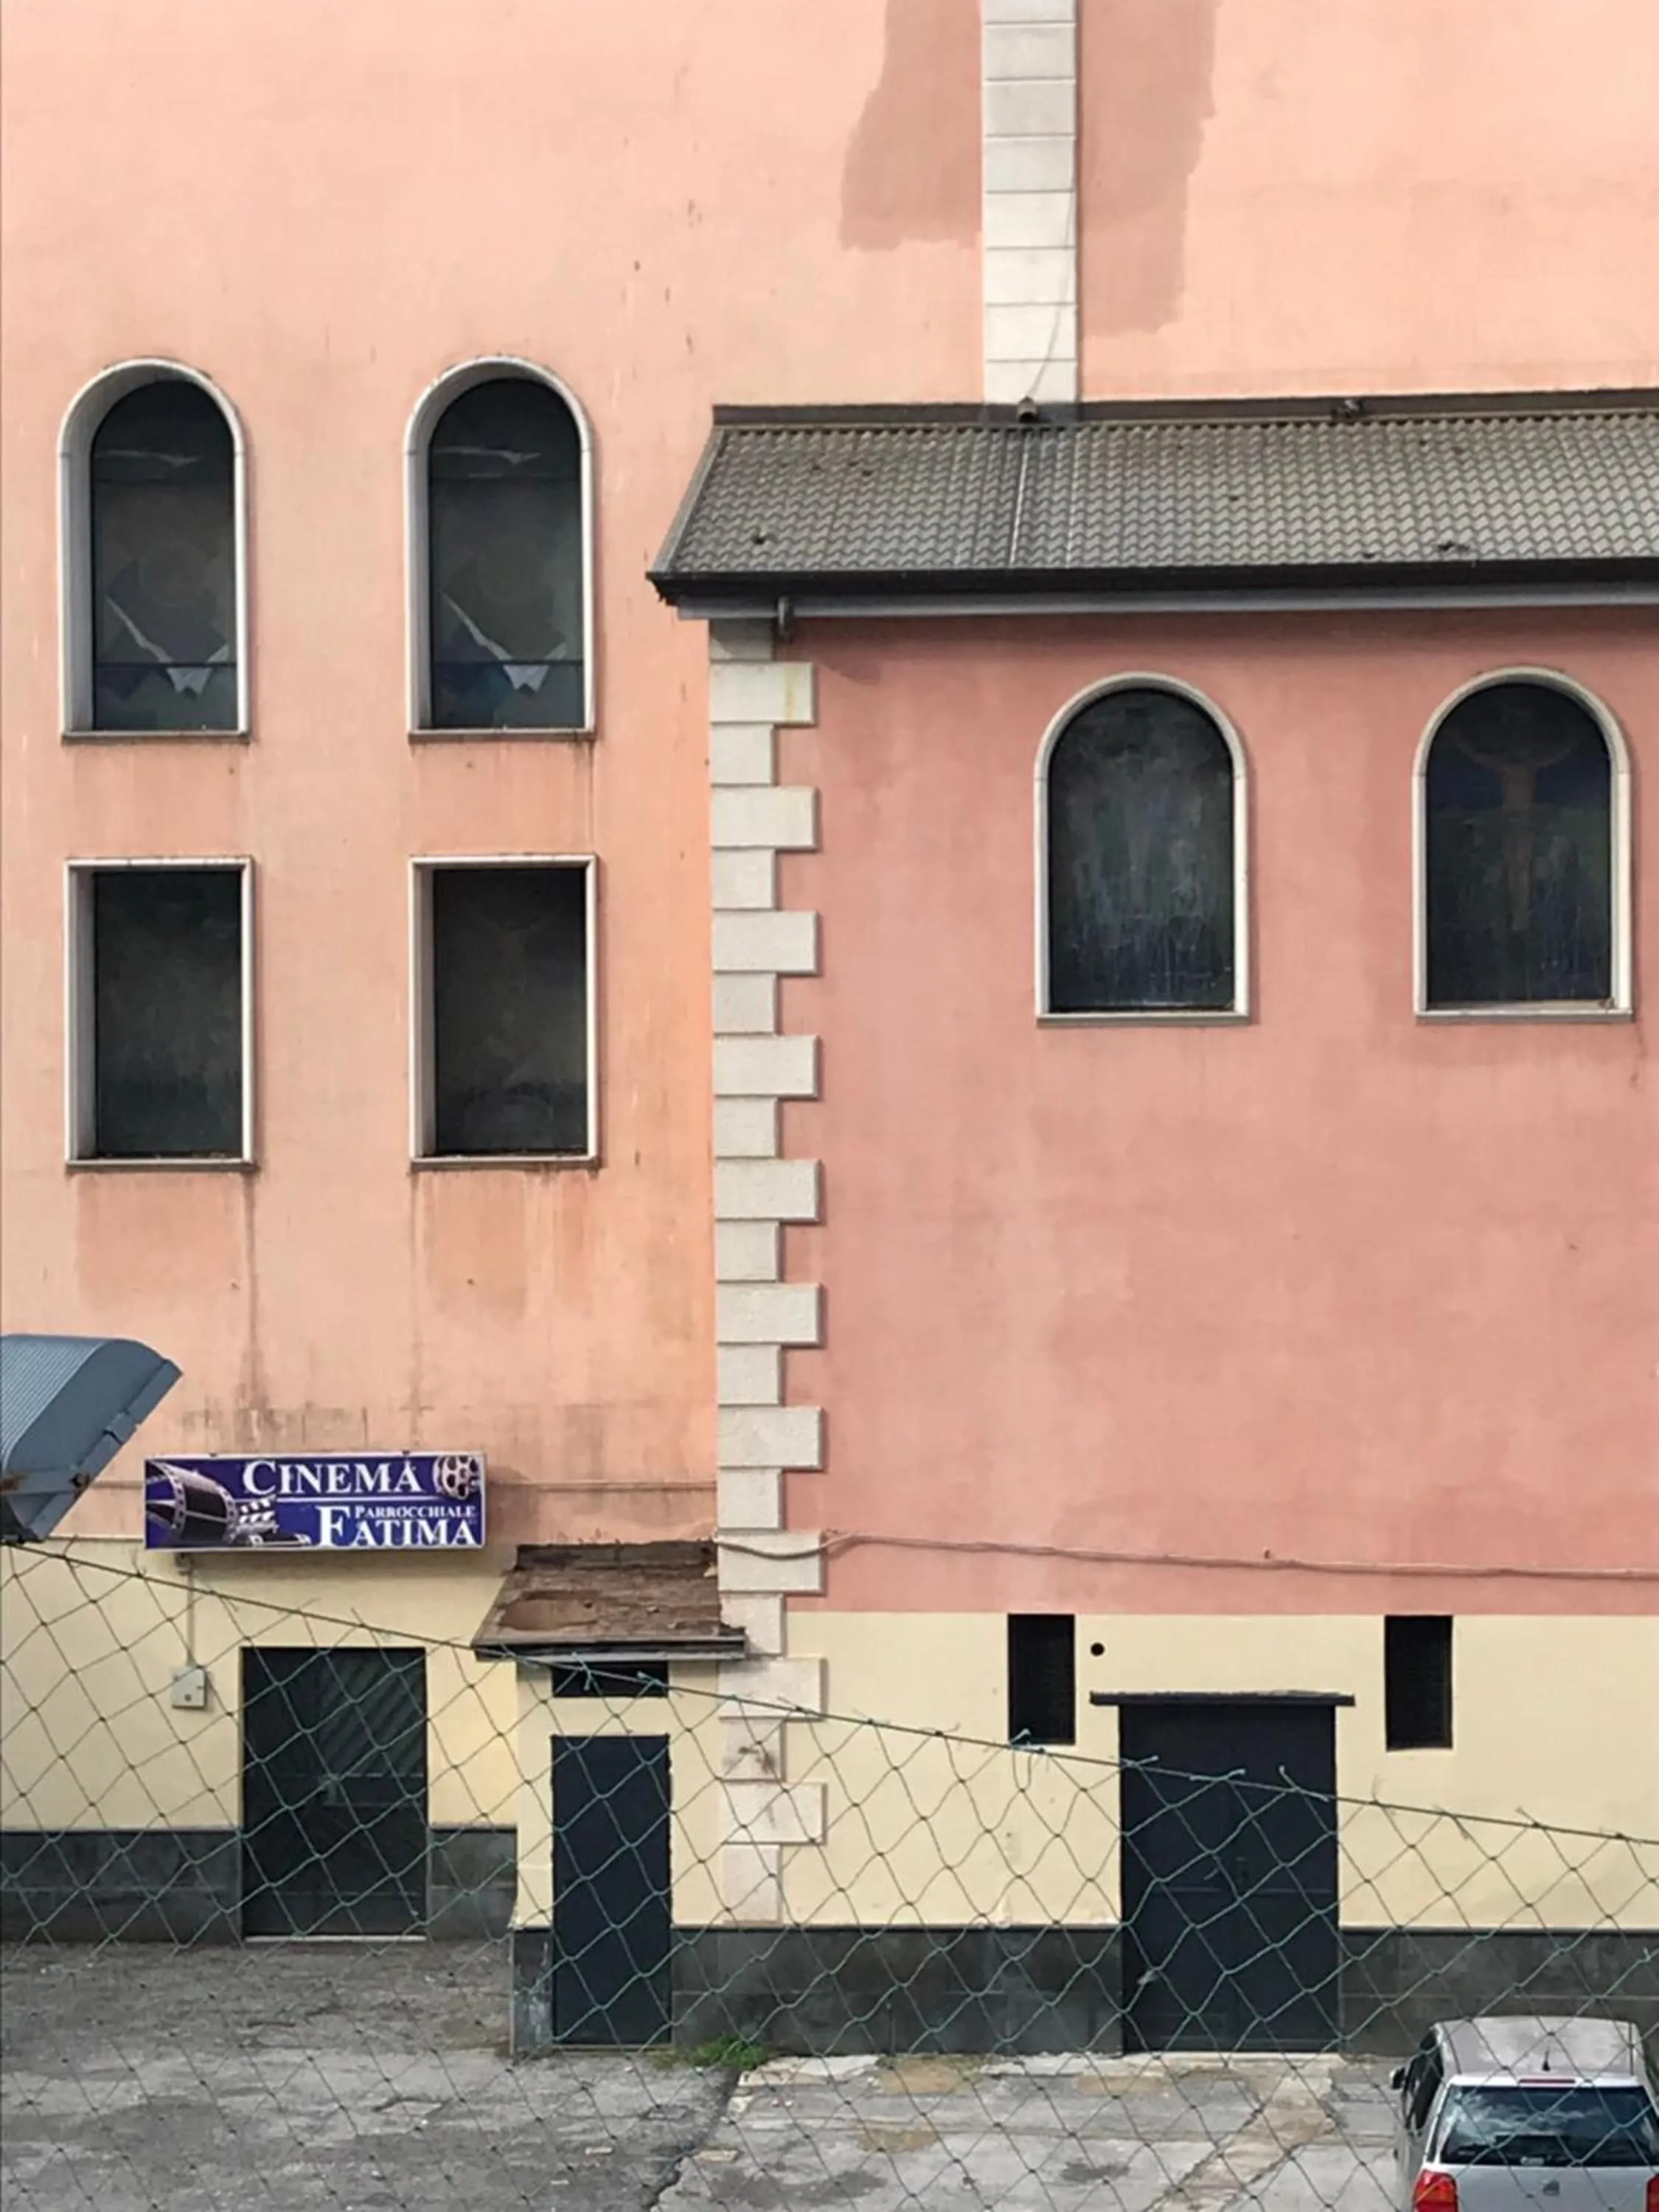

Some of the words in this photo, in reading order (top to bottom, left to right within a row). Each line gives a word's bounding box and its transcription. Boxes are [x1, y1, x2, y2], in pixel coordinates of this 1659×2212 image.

[243, 1460, 425, 1495] CINEMA
[316, 1506, 478, 1547] FATIMA
[355, 1506, 477, 1519] PARROCCHIALE
